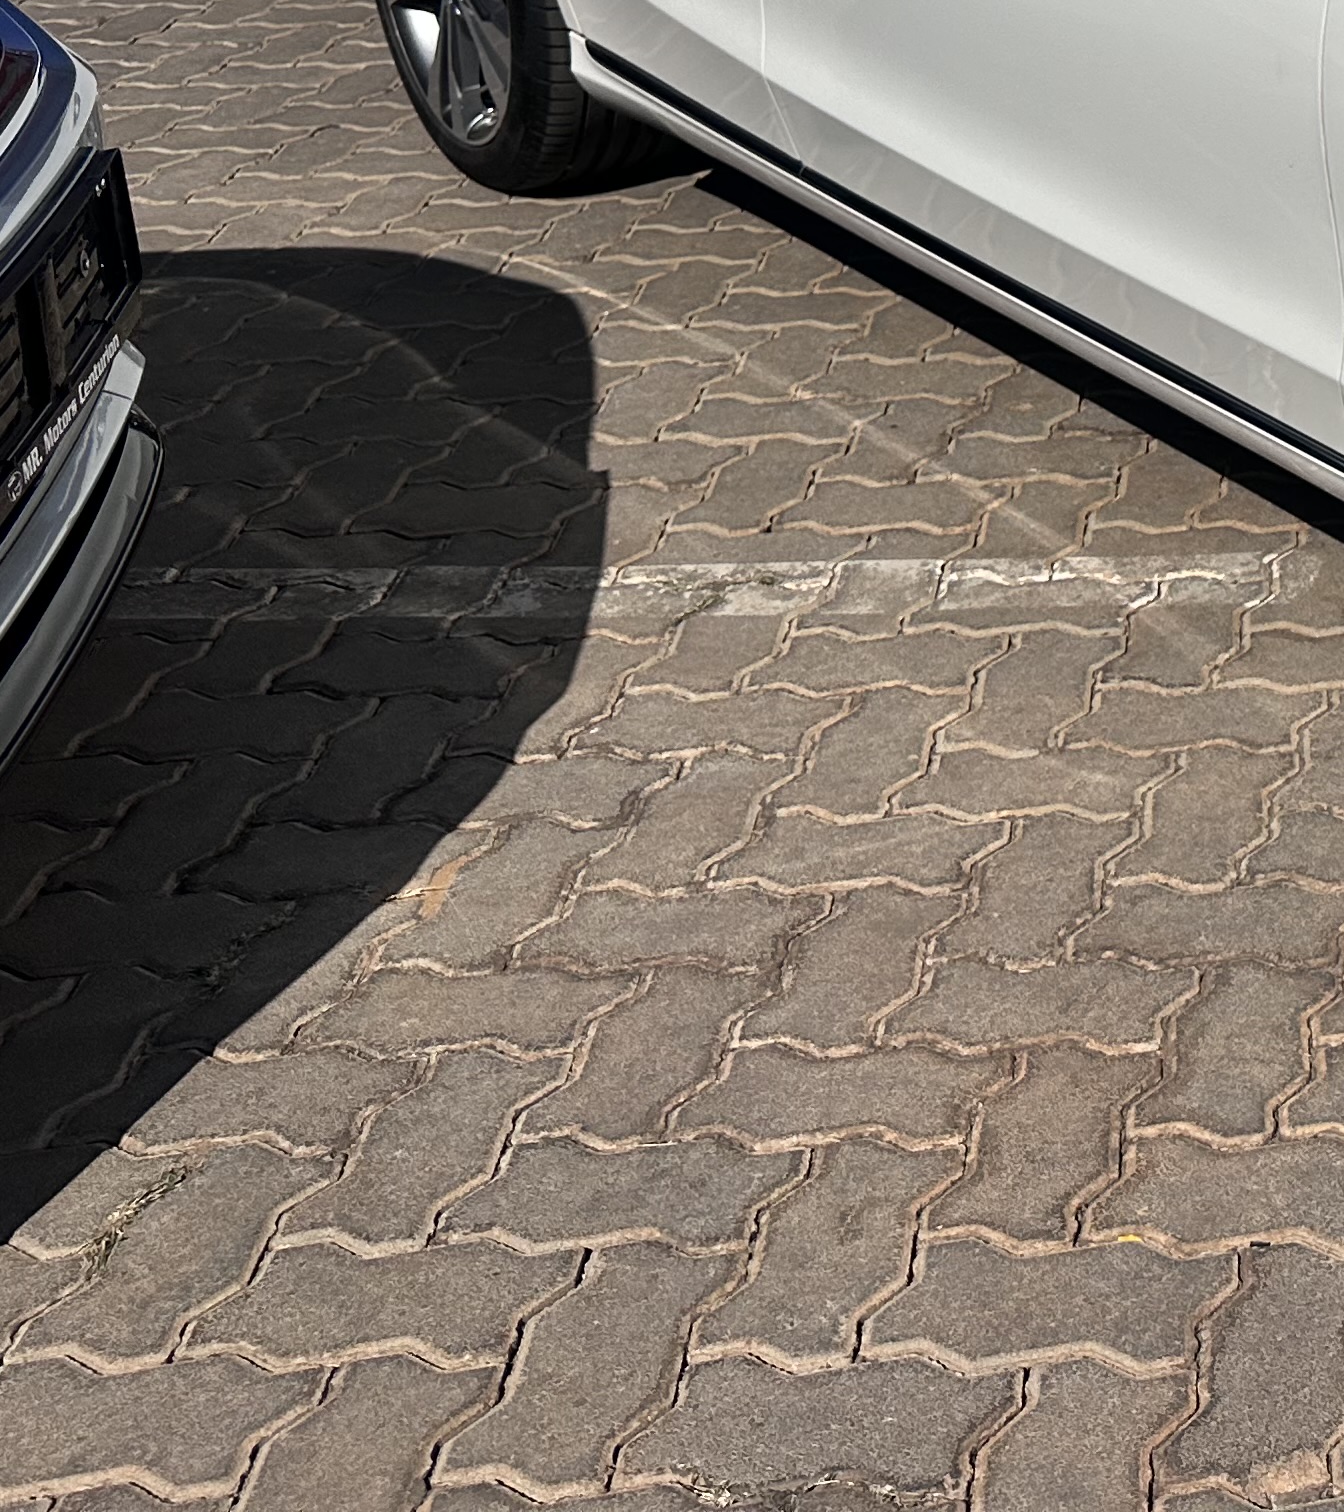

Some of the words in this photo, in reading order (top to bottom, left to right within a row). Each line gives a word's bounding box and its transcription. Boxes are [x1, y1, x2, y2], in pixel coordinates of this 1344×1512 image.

[21, 446, 43, 484] MR.
[43, 398, 77, 454] Motors
[78, 334, 120, 405] Centurion
